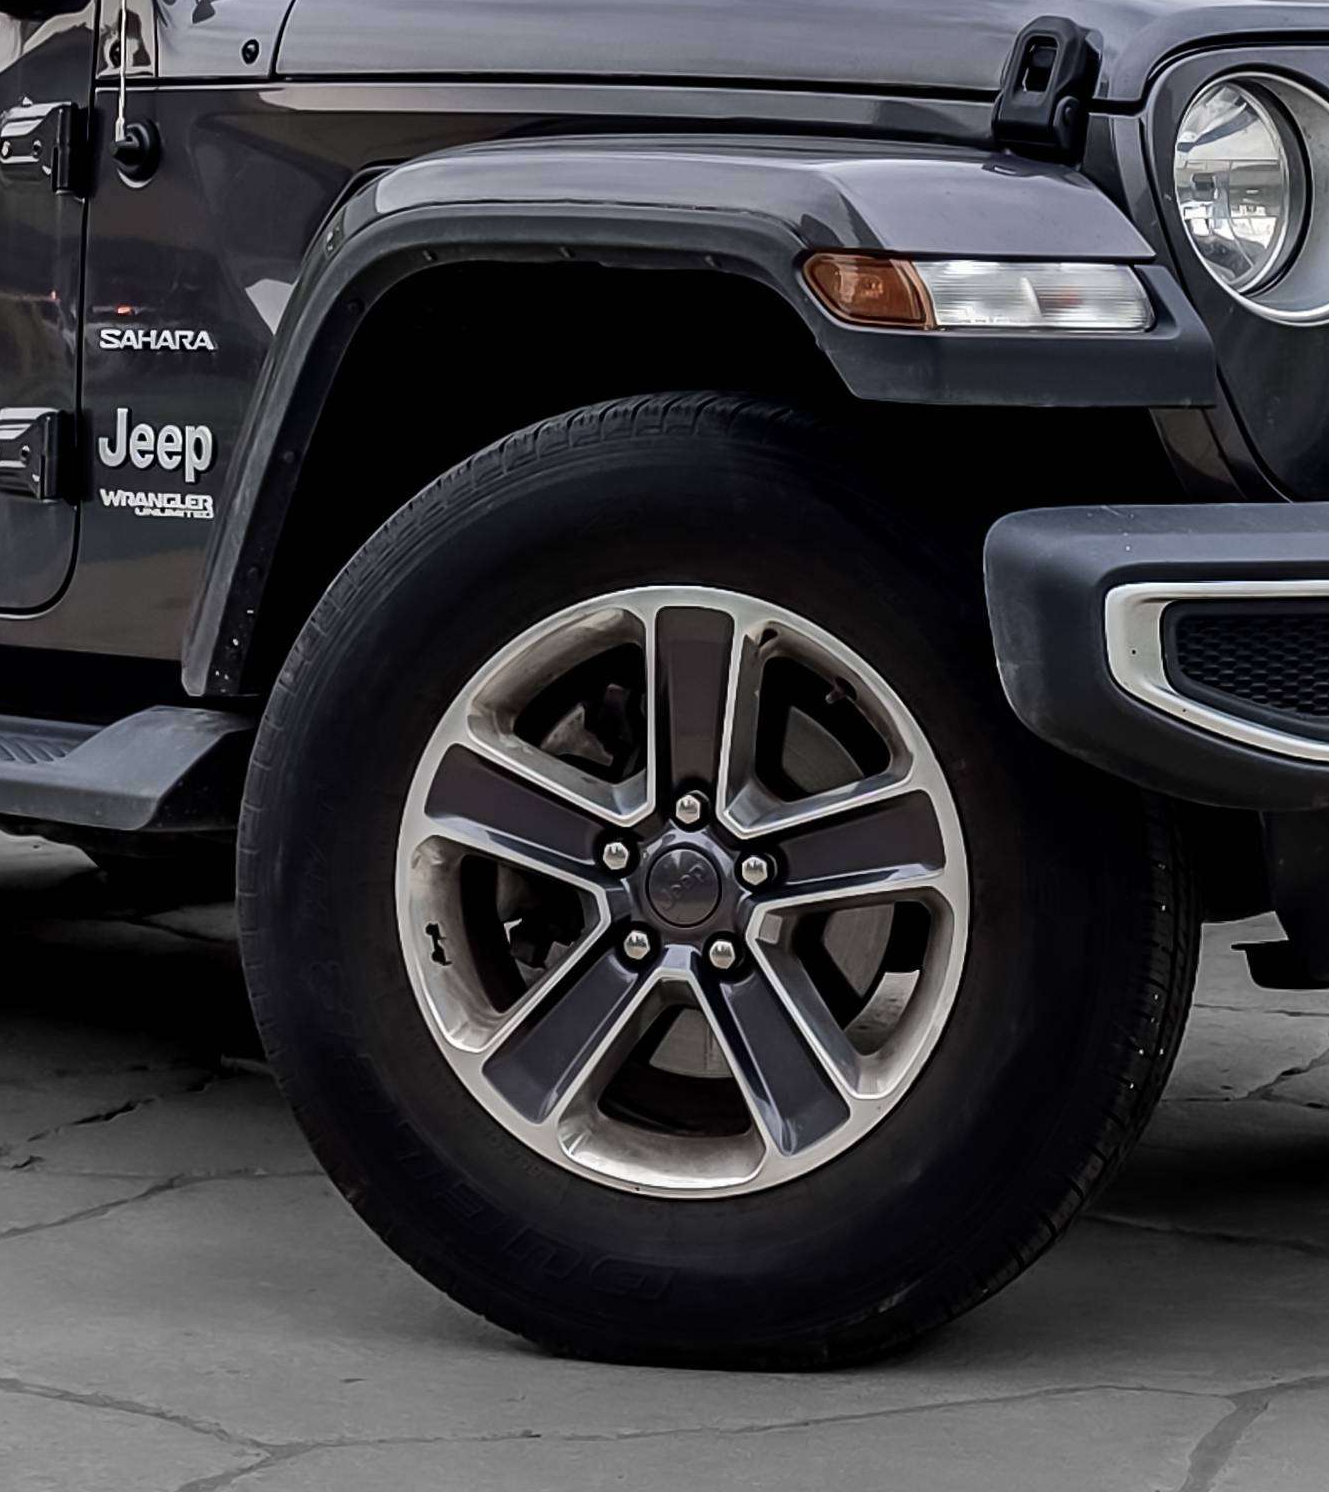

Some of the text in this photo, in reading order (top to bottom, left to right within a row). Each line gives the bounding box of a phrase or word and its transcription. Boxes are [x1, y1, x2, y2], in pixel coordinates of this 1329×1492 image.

[99, 329, 217, 350] SAHARA
[98, 407, 213, 483] Jeep
[99, 488, 214, 512] WRANGLER
